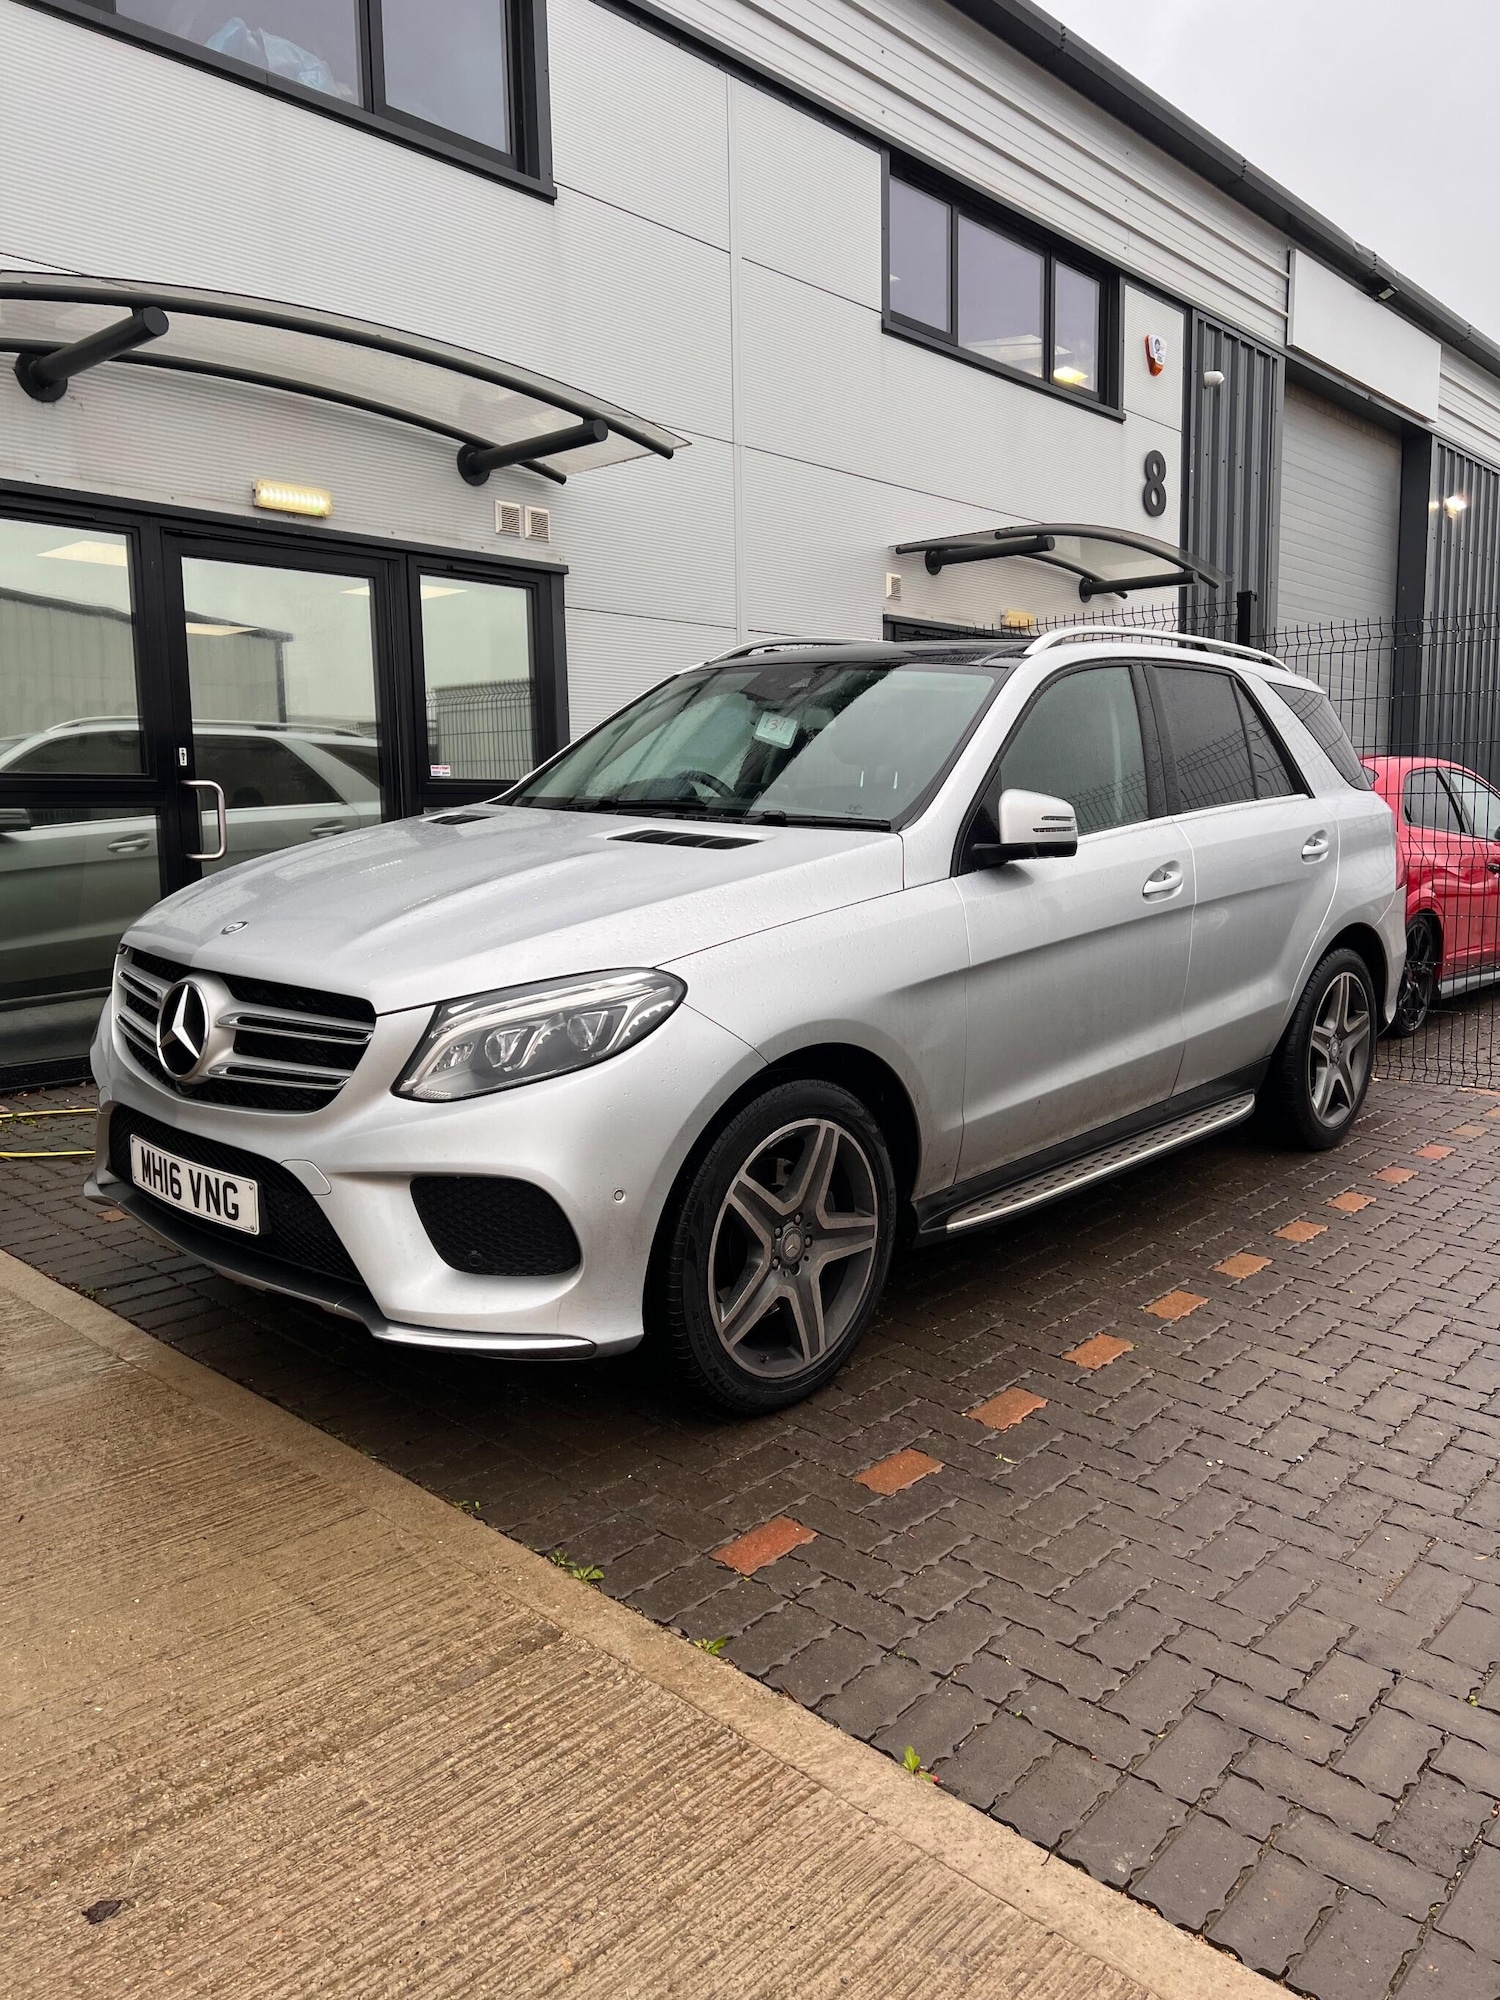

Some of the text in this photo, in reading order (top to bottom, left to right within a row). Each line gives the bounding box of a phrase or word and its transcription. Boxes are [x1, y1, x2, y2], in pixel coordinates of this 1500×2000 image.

[1142, 449, 1167, 517] 8
[140, 1145, 240, 1221] MH16 VNG
